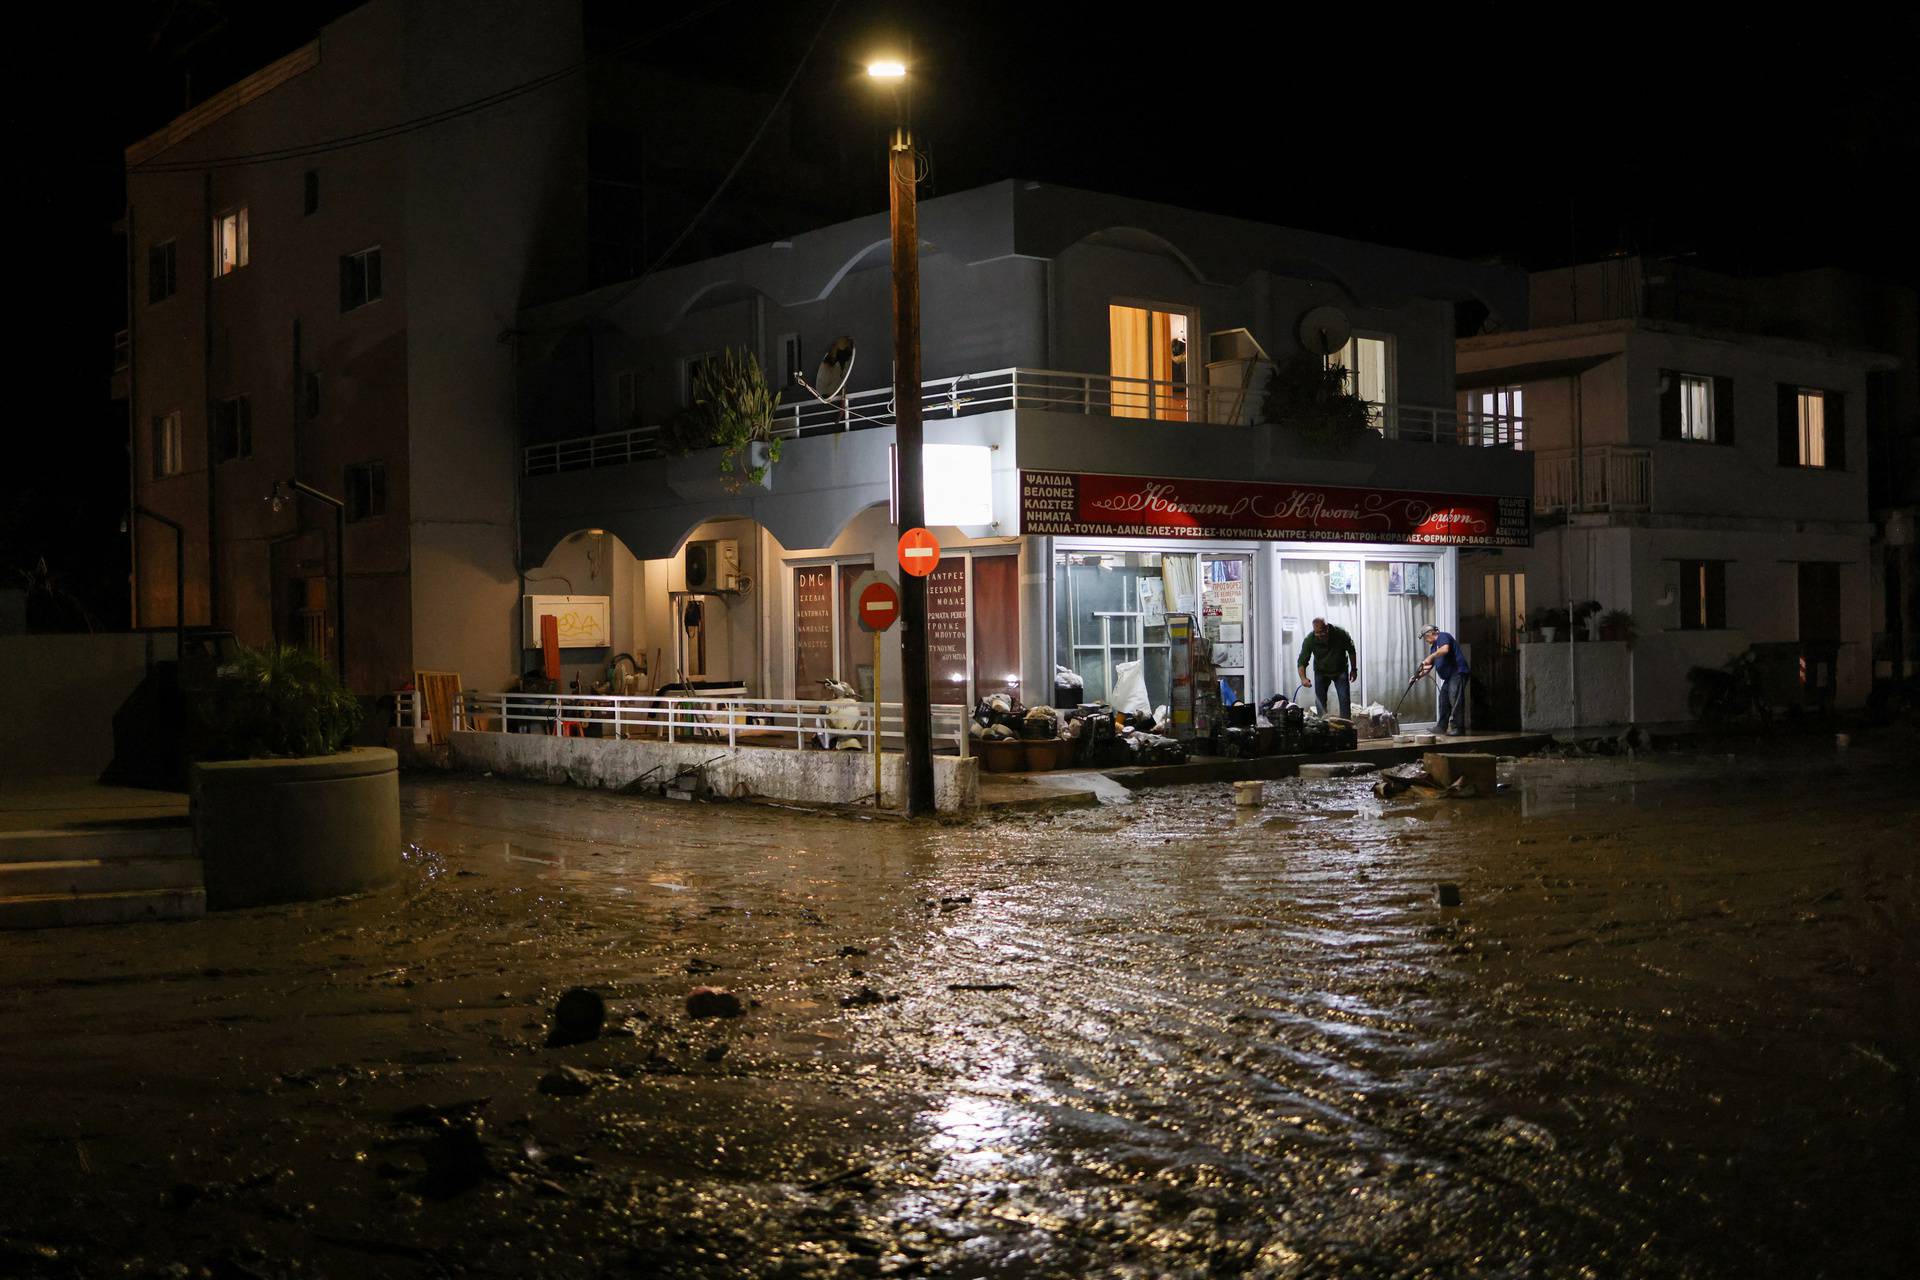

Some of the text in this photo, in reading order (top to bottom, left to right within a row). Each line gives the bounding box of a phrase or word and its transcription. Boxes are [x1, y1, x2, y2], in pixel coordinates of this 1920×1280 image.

[1026, 474, 1072, 486] ΨΑΛΙΔΙΑ
[1024, 487, 1075, 498] ΒΕΛΟΝΕΣ
[1024, 499, 1074, 510] ΚΛΩΣΤΕΣ
[1026, 511, 1072, 522] ΝΗΜΑΤΑ
[800, 573, 824, 587] DMC
[928, 585, 961, 594] ΞΕΣΟΥΑΡ
